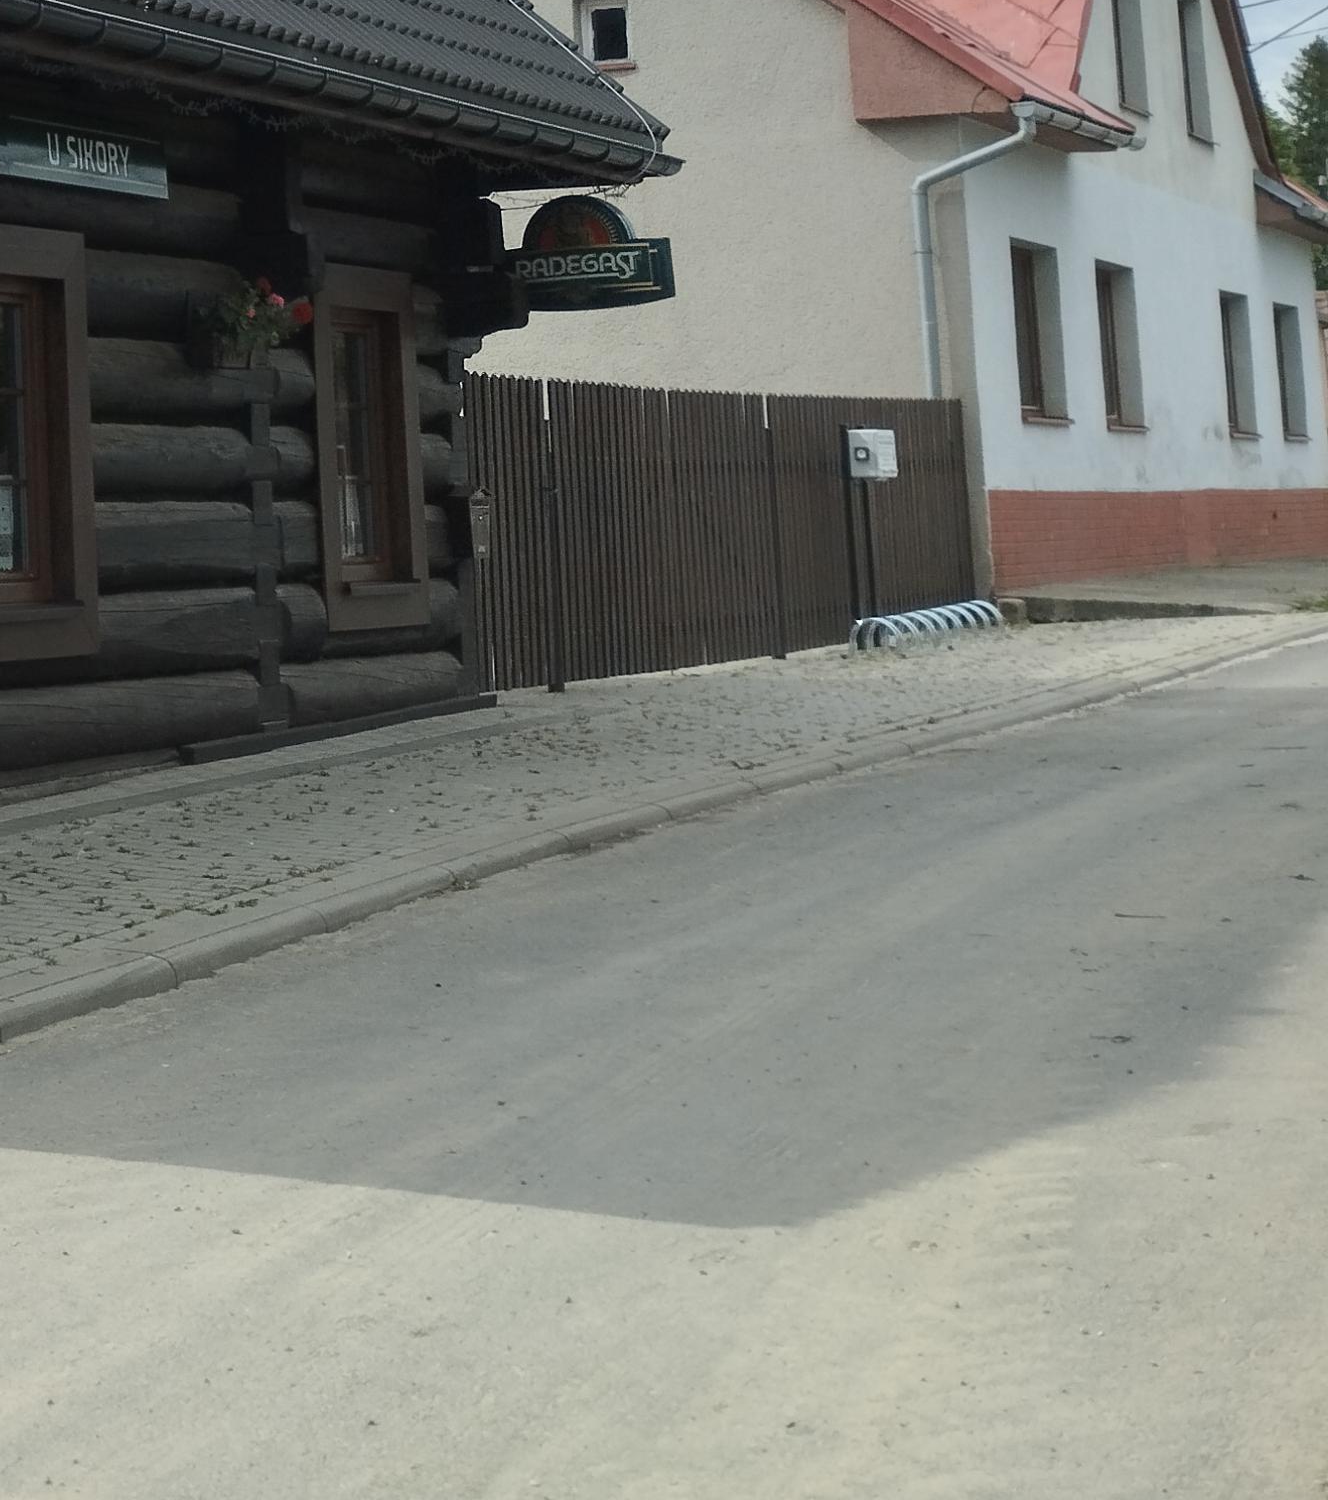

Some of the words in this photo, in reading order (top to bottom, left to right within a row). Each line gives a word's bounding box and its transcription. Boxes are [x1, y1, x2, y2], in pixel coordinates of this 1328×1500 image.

[46, 132, 60, 165] U
[67, 137, 131, 177] SIKORY
[515, 251, 641, 279] RADEGAST
